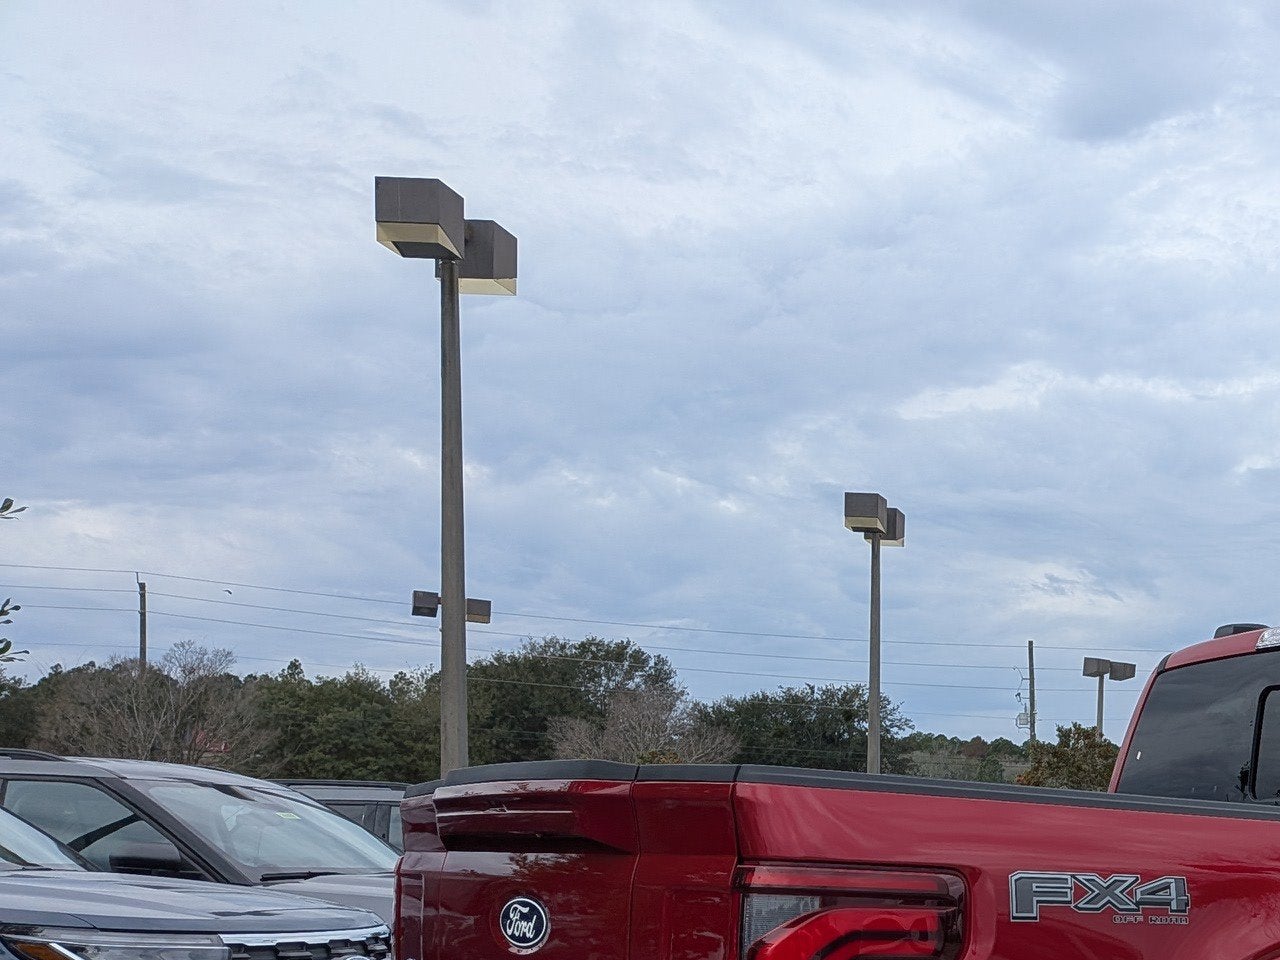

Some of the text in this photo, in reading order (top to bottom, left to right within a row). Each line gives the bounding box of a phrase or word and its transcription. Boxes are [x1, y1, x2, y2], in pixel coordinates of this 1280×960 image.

[1009, 870, 1191, 923] FX4
[506, 904, 537, 939] Ford
[1113, 915, 1189, 925] OFF ROAD
